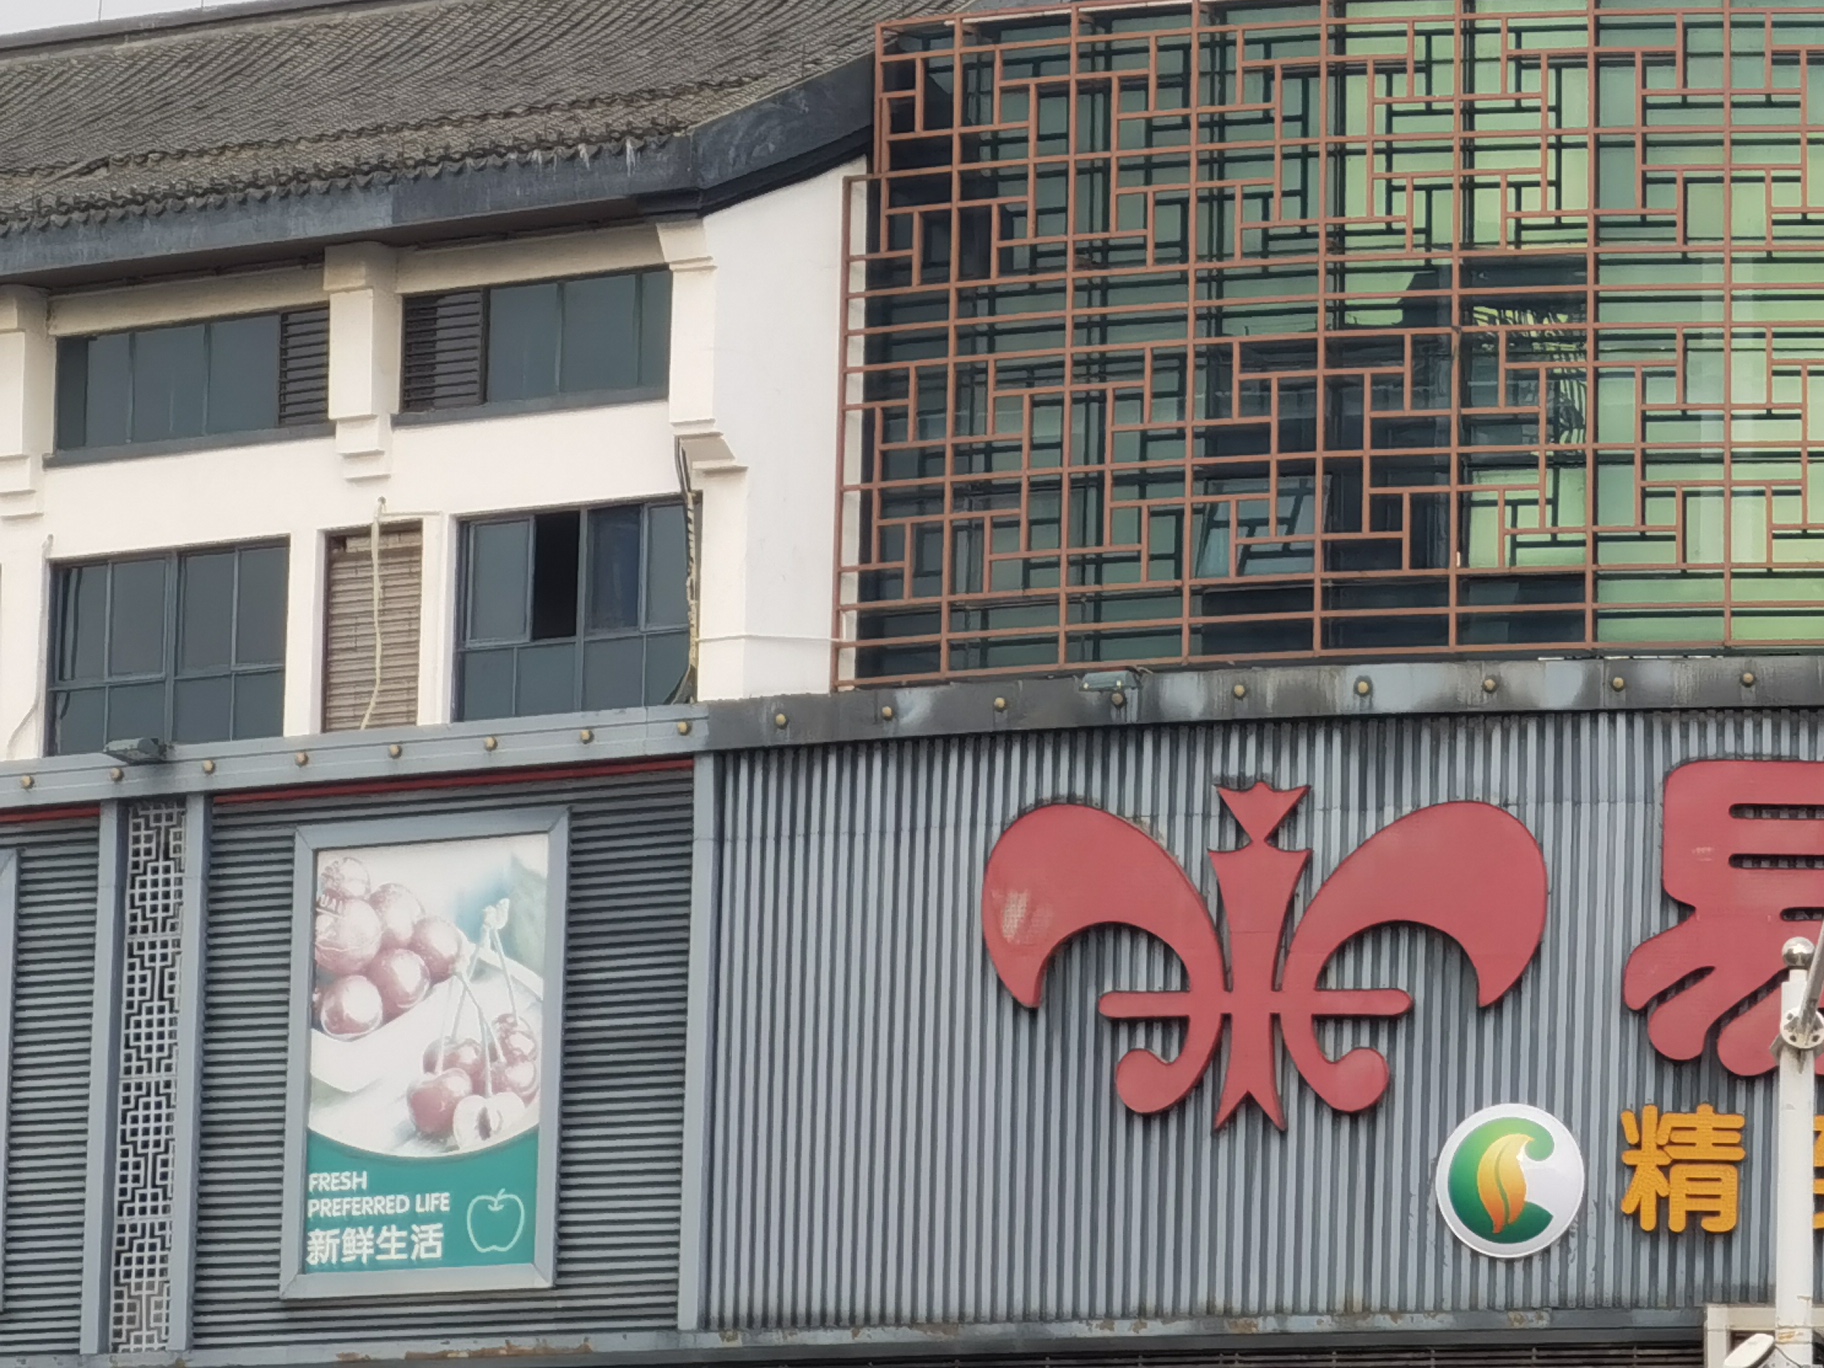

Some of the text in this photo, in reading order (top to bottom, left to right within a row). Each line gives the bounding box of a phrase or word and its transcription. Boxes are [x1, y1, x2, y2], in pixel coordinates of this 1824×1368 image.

[308, 1170, 368, 1193] FRESH
[307, 1191, 451, 1219] PREFERRED LIFE
[305, 1223, 445, 1266] 新鲜生活
